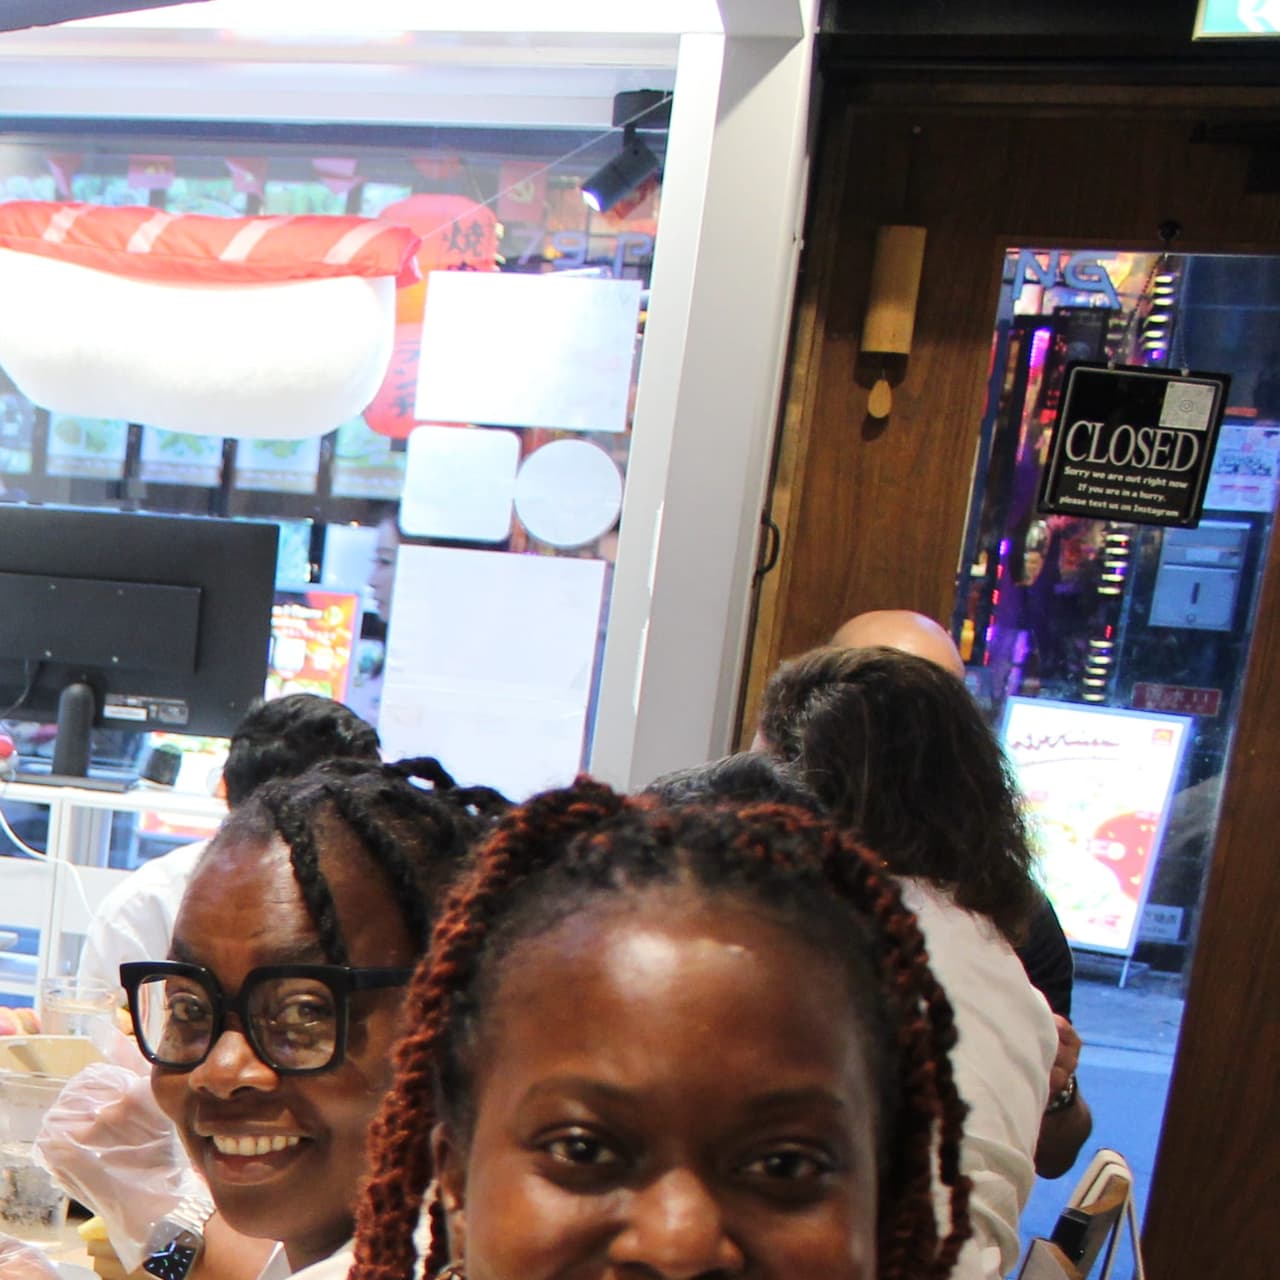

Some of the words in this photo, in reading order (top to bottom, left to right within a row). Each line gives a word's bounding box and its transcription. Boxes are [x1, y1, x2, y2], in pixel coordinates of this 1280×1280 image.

[1065, 420, 1199, 472] CLOSED
[1064, 466, 1090, 479] Sorry
[1092, 471, 1106, 479] we
[1107, 473, 1124, 481] are
[1125, 475, 1141, 484] out
[1143, 476, 1167, 487] right
[1168, 481, 1189, 489] now
[1078, 482, 1088, 492] If
[1088, 485, 1105, 494] you
[1105, 488, 1121, 496] are
[1121, 488, 1130, 497] in
[1059, 496, 1087, 506] please
[1088, 499, 1107, 508] text
[1133, 504, 1179, 517] Instagram
